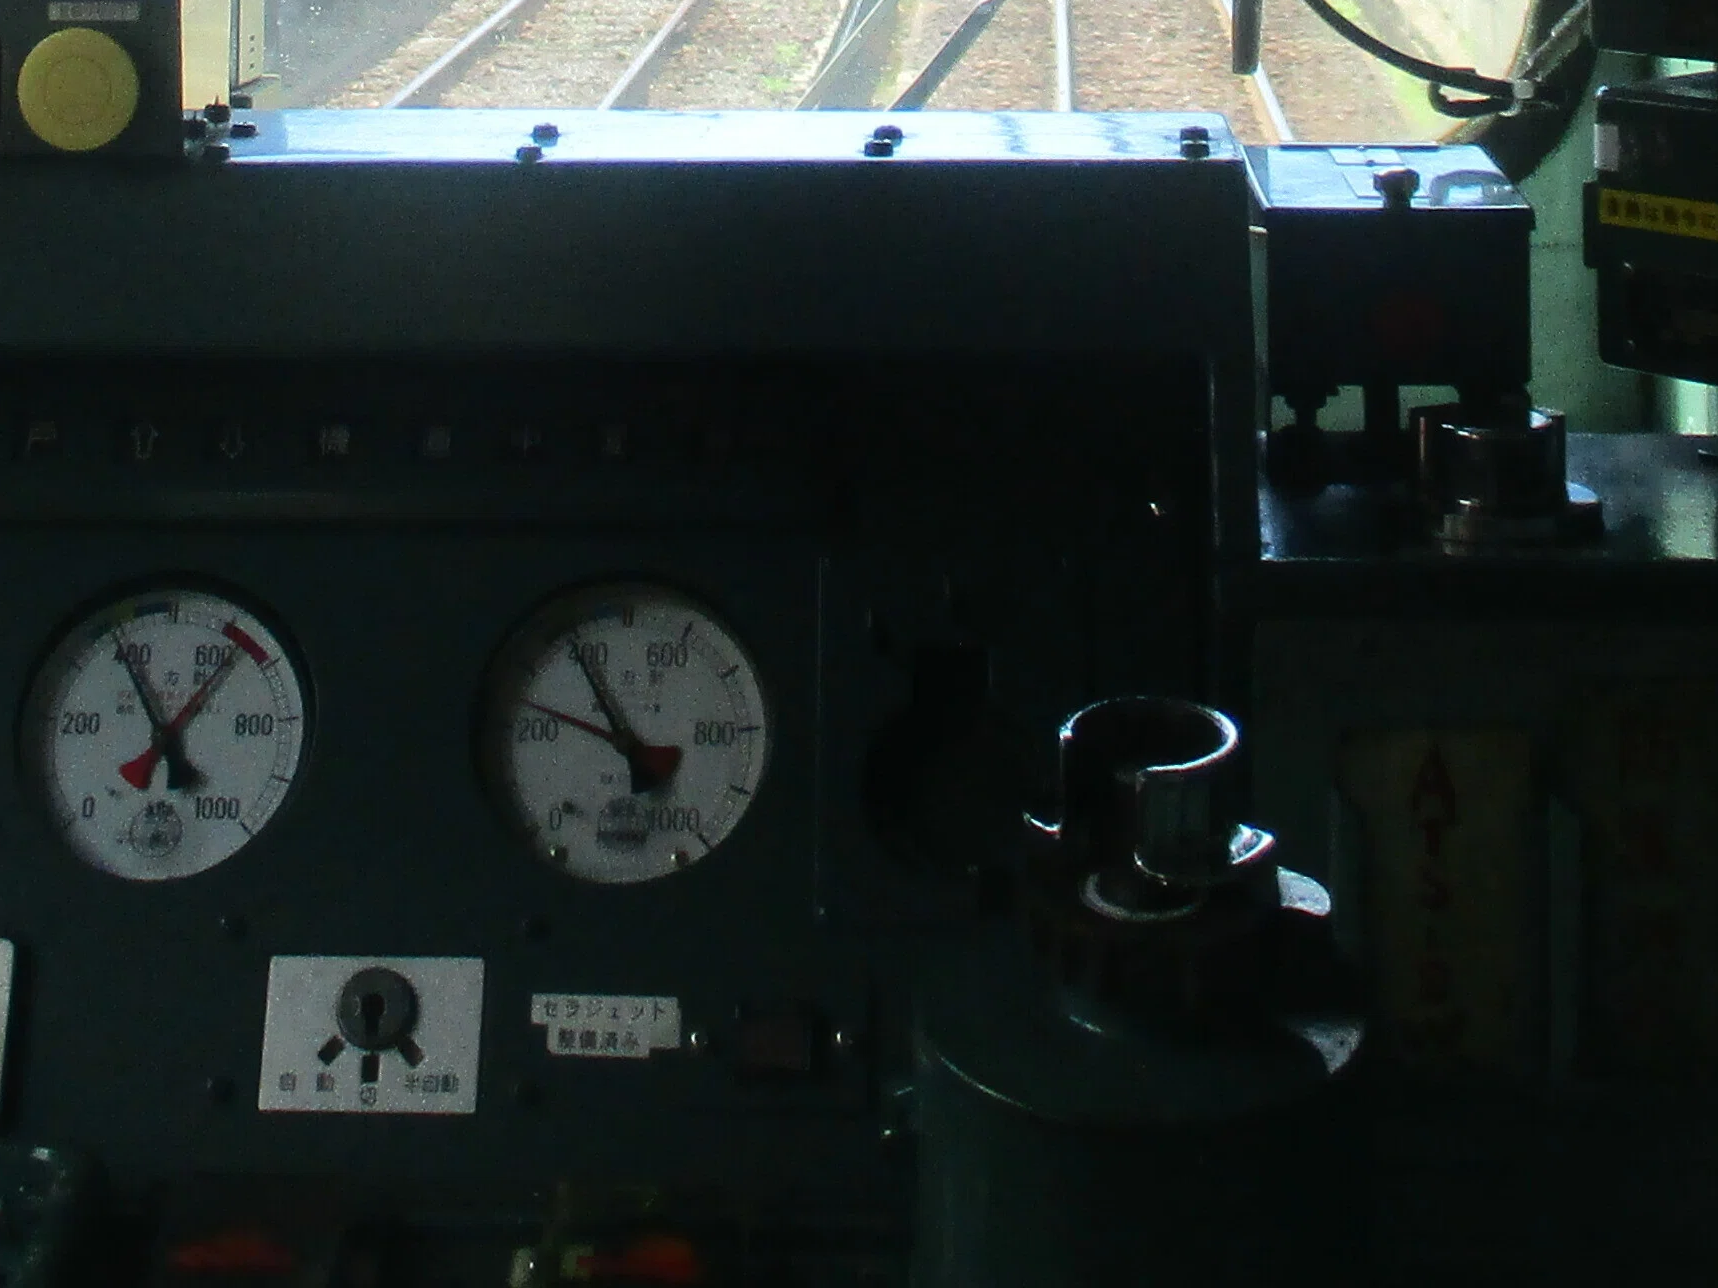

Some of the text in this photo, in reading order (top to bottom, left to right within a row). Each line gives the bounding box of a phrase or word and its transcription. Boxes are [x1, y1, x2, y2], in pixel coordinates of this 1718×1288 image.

[112, 641, 235, 668] 400 600
[567, 638, 689, 668] 400 600
[61, 710, 276, 738] 200 800
[516, 715, 735, 747] 200 800
[81, 793, 95, 820] 0
[194, 796, 241, 821] 1000
[548, 807, 562, 832] 0
[649, 807, 701, 833] 1000
[544, 998, 666, 1022] セラジェット
[557, 1027, 641, 1051] 整備済み
[278, 1071, 336, 1093] 自動
[403, 1073, 460, 1094] 半自動
